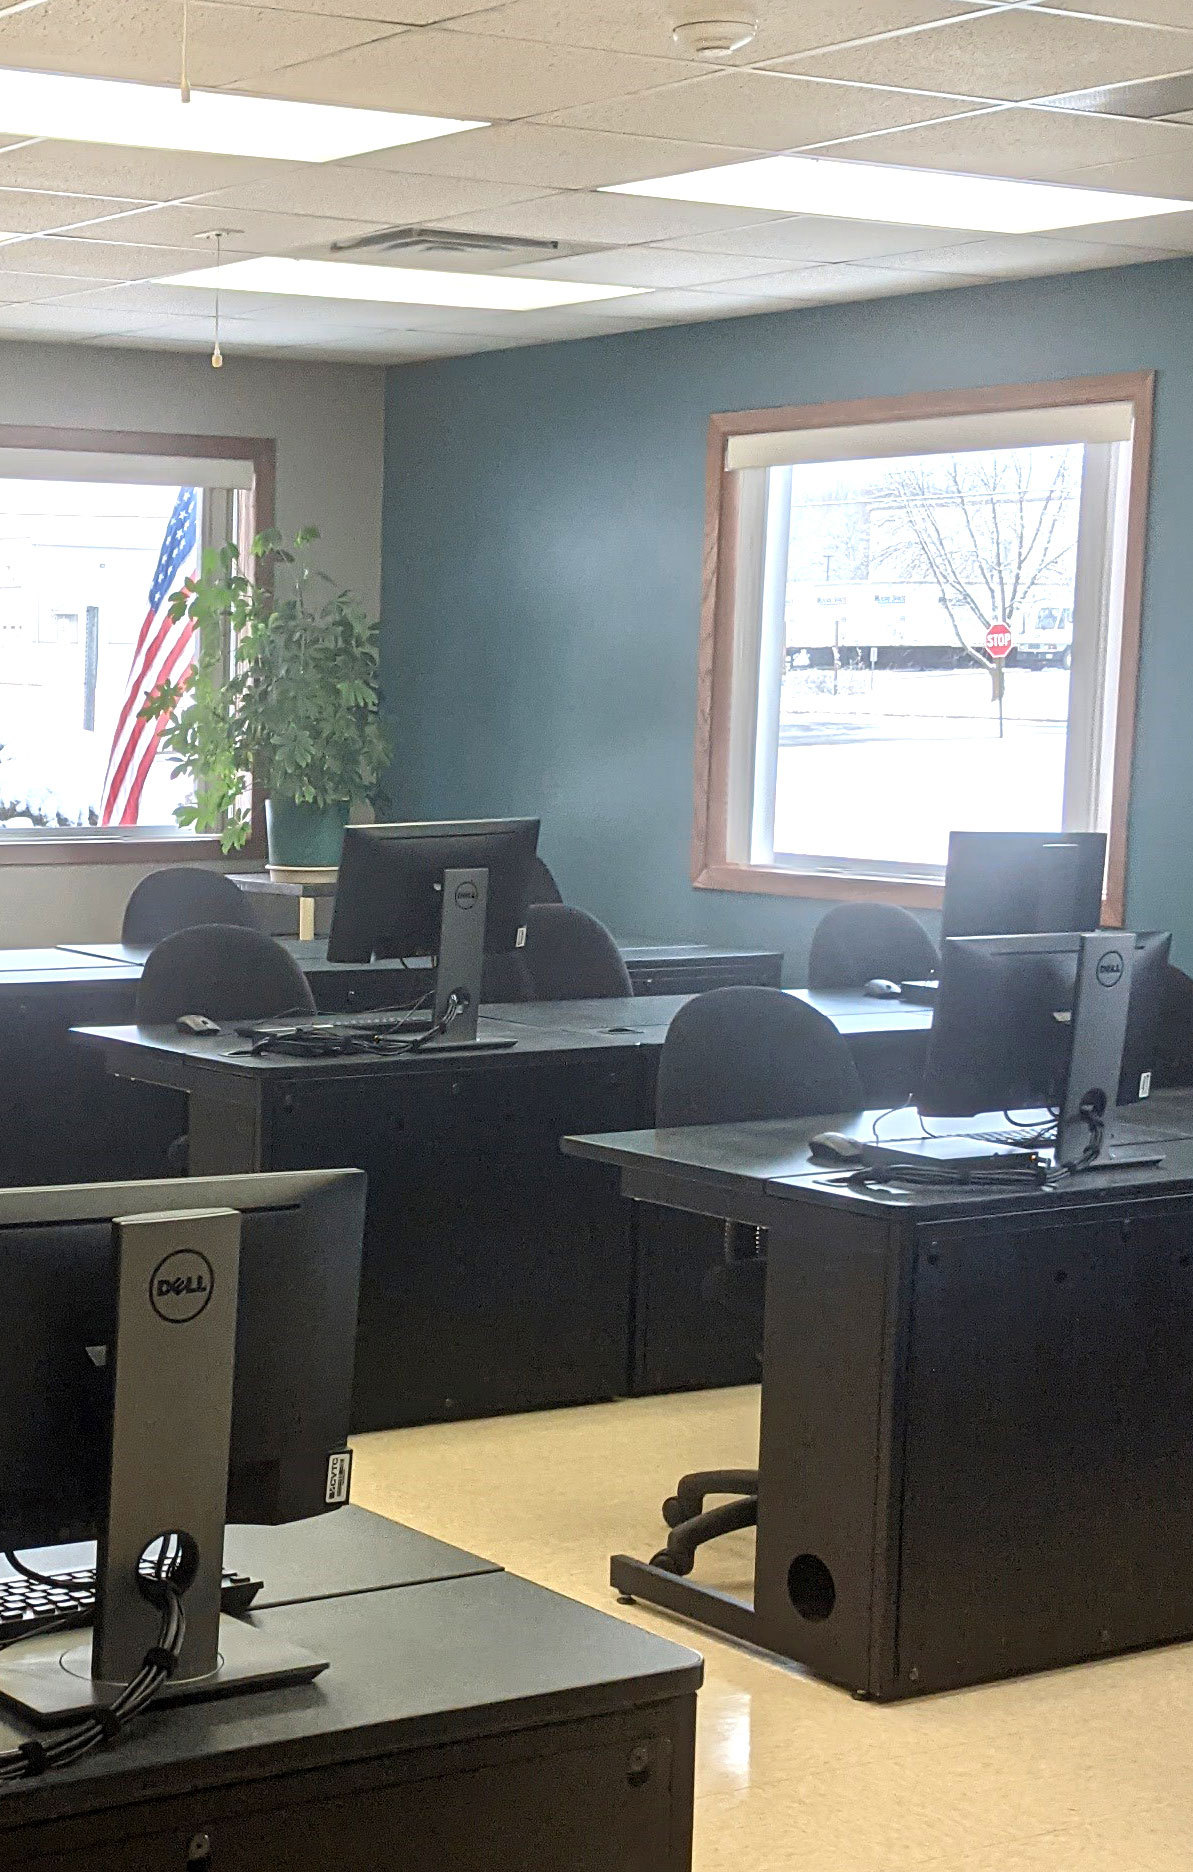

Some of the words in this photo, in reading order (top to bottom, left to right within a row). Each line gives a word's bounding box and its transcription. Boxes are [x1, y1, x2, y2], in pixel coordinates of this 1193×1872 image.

[986, 632, 1011, 648] STOP
[1099, 964, 1120, 973] DELL
[157, 1274, 207, 1297] DELL
[330, 1457, 339, 1487] CVTC
